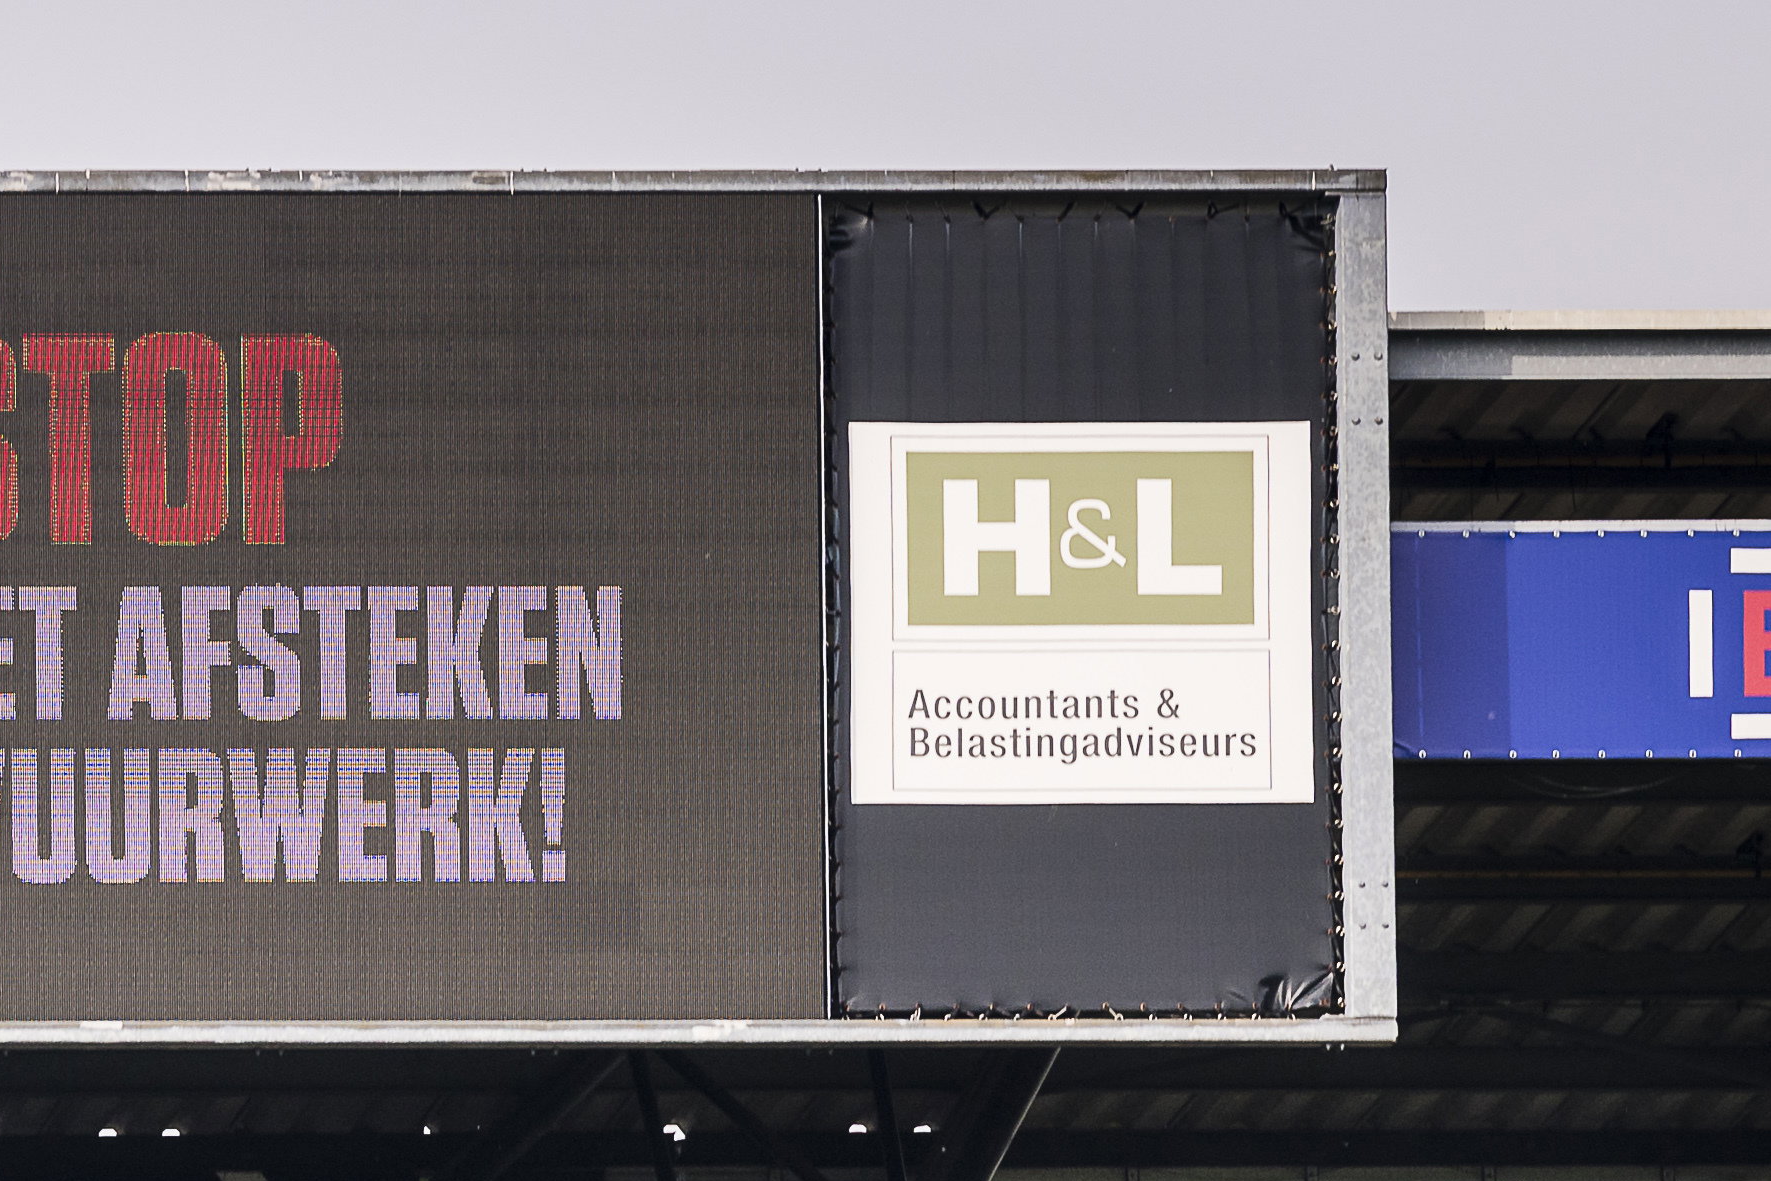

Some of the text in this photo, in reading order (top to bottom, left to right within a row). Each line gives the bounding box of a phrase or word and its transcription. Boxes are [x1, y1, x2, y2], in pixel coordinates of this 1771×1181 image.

[942, 478, 1224, 596] H&L
[107, 584, 623, 721] AFSTEKEN
[908, 688, 1181, 722] Accountants &
[909, 726, 1258, 765] Belastingadviseurs
